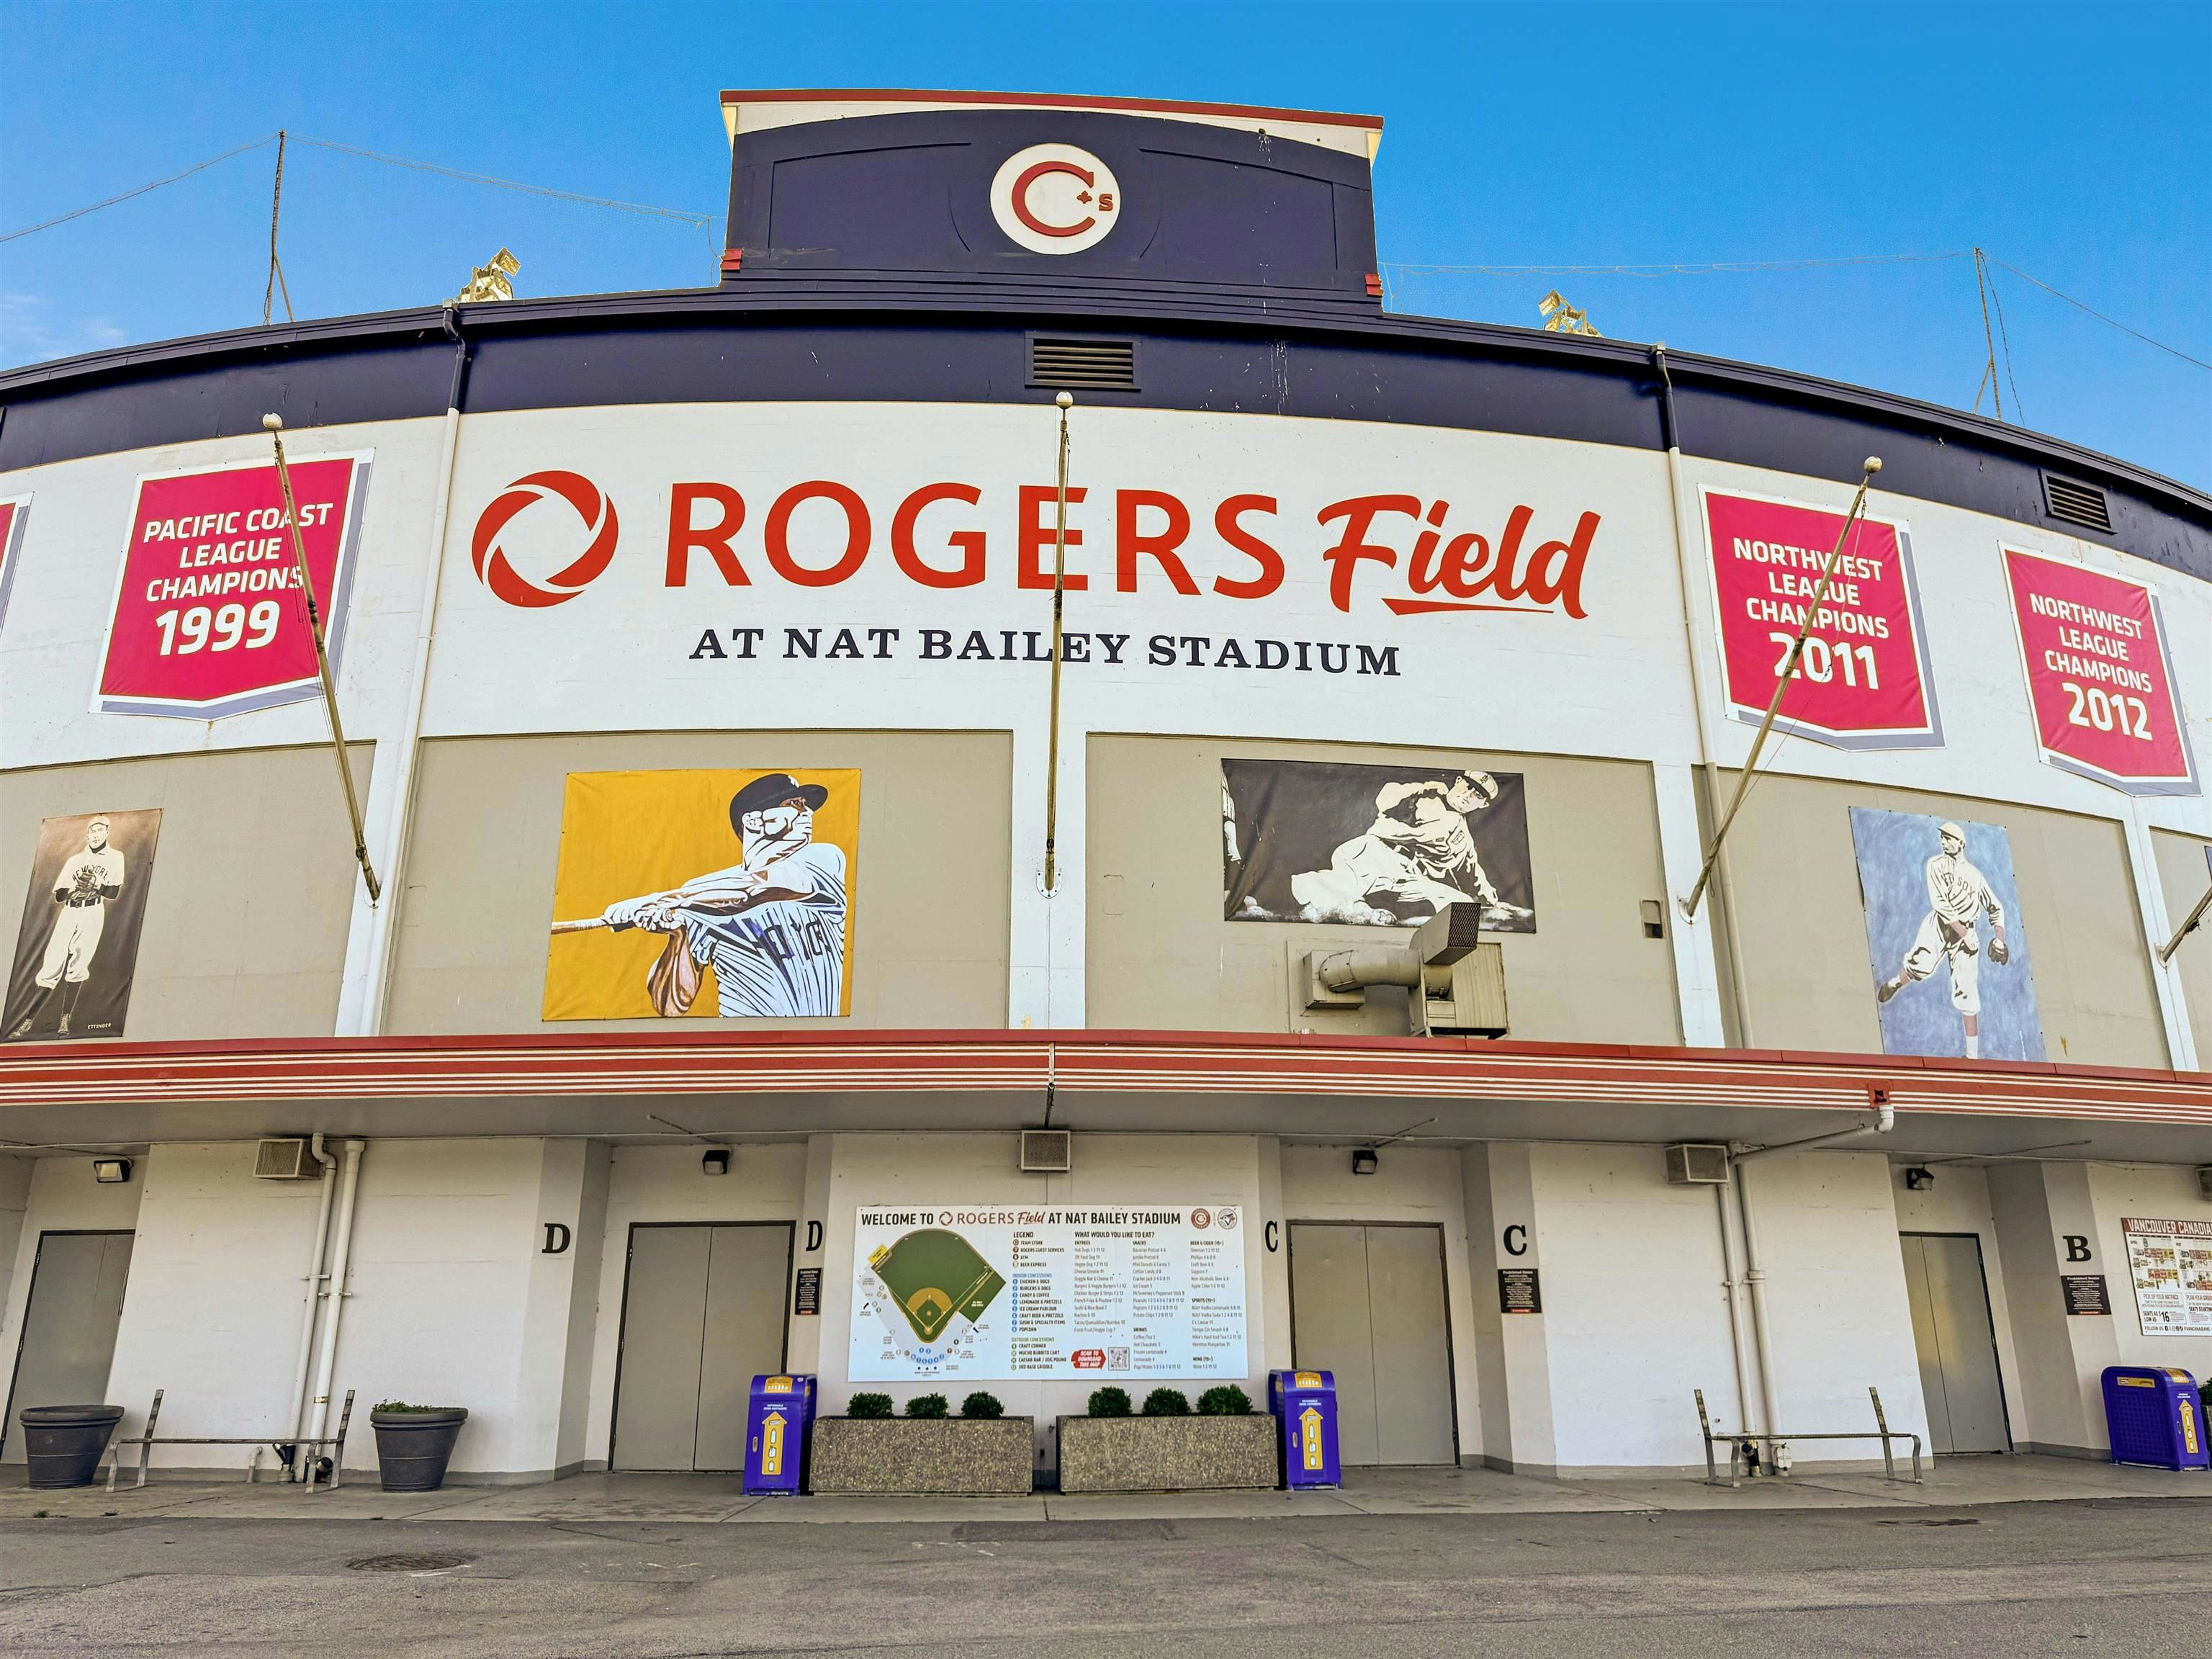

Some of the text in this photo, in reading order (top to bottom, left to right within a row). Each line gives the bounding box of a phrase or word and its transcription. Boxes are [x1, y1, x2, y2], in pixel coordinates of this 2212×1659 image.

[143, 503, 333, 542] PACIFIC COAST
[179, 538, 282, 568] LEAGUE
[665, 480, 1601, 619] ROGERS Field
[1733, 537, 1883, 582] NORTHWEST
[146, 566, 304, 601] CHAMPIONS
[156, 601, 280, 656] 1999
[1746, 597, 1889, 639] CHAMPIONS
[2029, 593, 2142, 640] NORTHWEST
[689, 629, 1401, 676] AT NAT BAILEY STADIUM
[1769, 632, 1879, 690] 2011
[2059, 626, 2128, 662] LEAGUE
[2045, 649, 2152, 693] CHAMPIONS
[2062, 682, 2152, 741] 2012
[806, 1220, 823, 1251] D
[862, 1213, 916, 1225] WELCOME
[920, 1213, 933, 1225] TO
[957, 1213, 1015, 1224] ROGERS
[1018, 1211, 1045, 1225] Field
[1048, 1213, 1062, 1224] AT
[1066, 1213, 1088, 1224] NAT
[1091, 1213, 1128, 1224] BAILEY
[1132, 1213, 1180, 1224] STADIUM
[1265, 1220, 1278, 1252] C
[2128, 1219, 2212, 1235] VANCOUVER CANADIA
[541, 1223, 570, 1254] D
[1503, 1225, 1527, 1256] C
[2062, 1235, 2092, 1262] B
